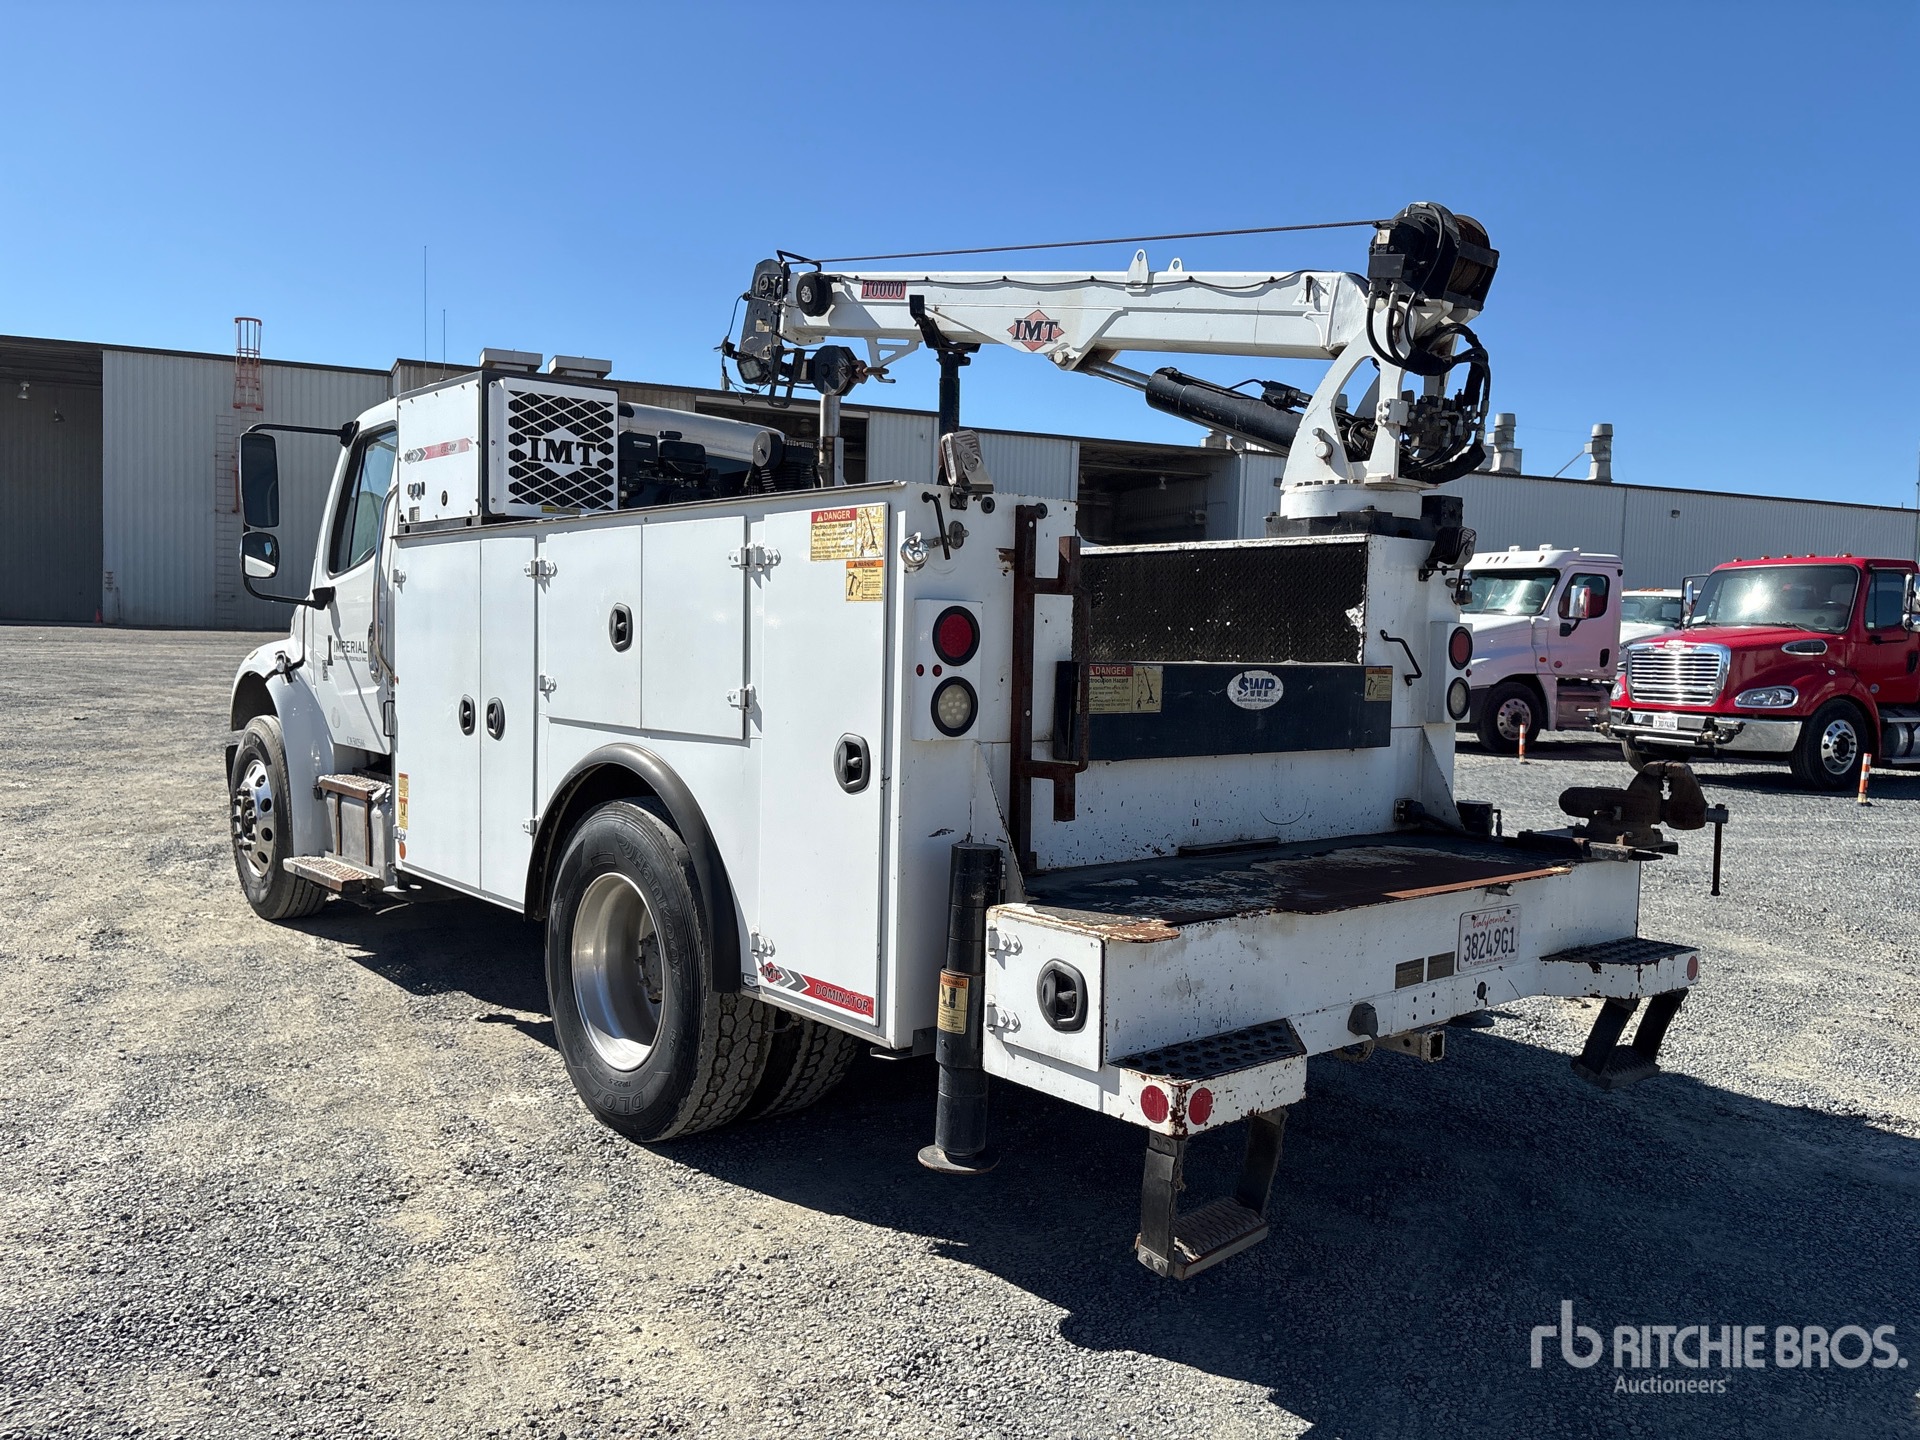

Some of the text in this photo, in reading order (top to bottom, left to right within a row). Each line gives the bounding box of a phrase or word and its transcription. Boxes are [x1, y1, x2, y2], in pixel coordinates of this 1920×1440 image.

[863, 281, 903, 298] 10000
[1013, 319, 1059, 342] IMT
[528, 436, 597, 467] IMT
[823, 510, 851, 521] DANGER
[333, 640, 367, 654] IMPERIAL
[1095, 666, 1127, 675] DANGER
[1238, 677, 1276, 697] SWP
[1472, 913, 1510, 930] California
[1464, 926, 1516, 963] 38249G1
[761, 965, 780, 980] IMT
[815, 983, 869, 1012] DOMINATOR
